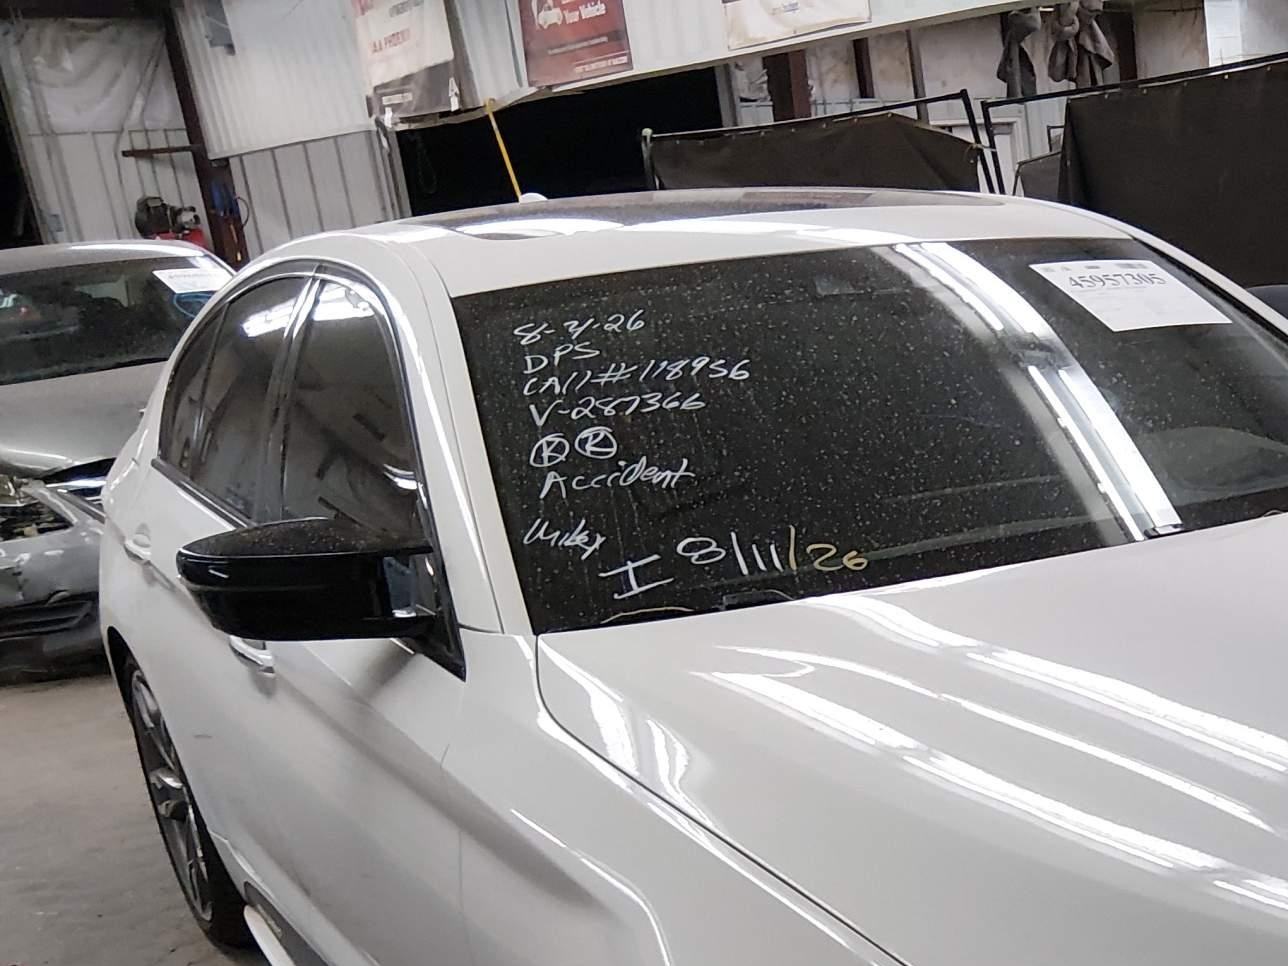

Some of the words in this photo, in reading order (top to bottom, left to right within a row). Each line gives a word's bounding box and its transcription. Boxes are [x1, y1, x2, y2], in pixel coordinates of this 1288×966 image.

[1068, 273, 1167, 288] 45957305
[523, 341, 600, 374] DPS
[539, 456, 696, 499] Accident
[676, 525, 868, 577] 8/11/26
